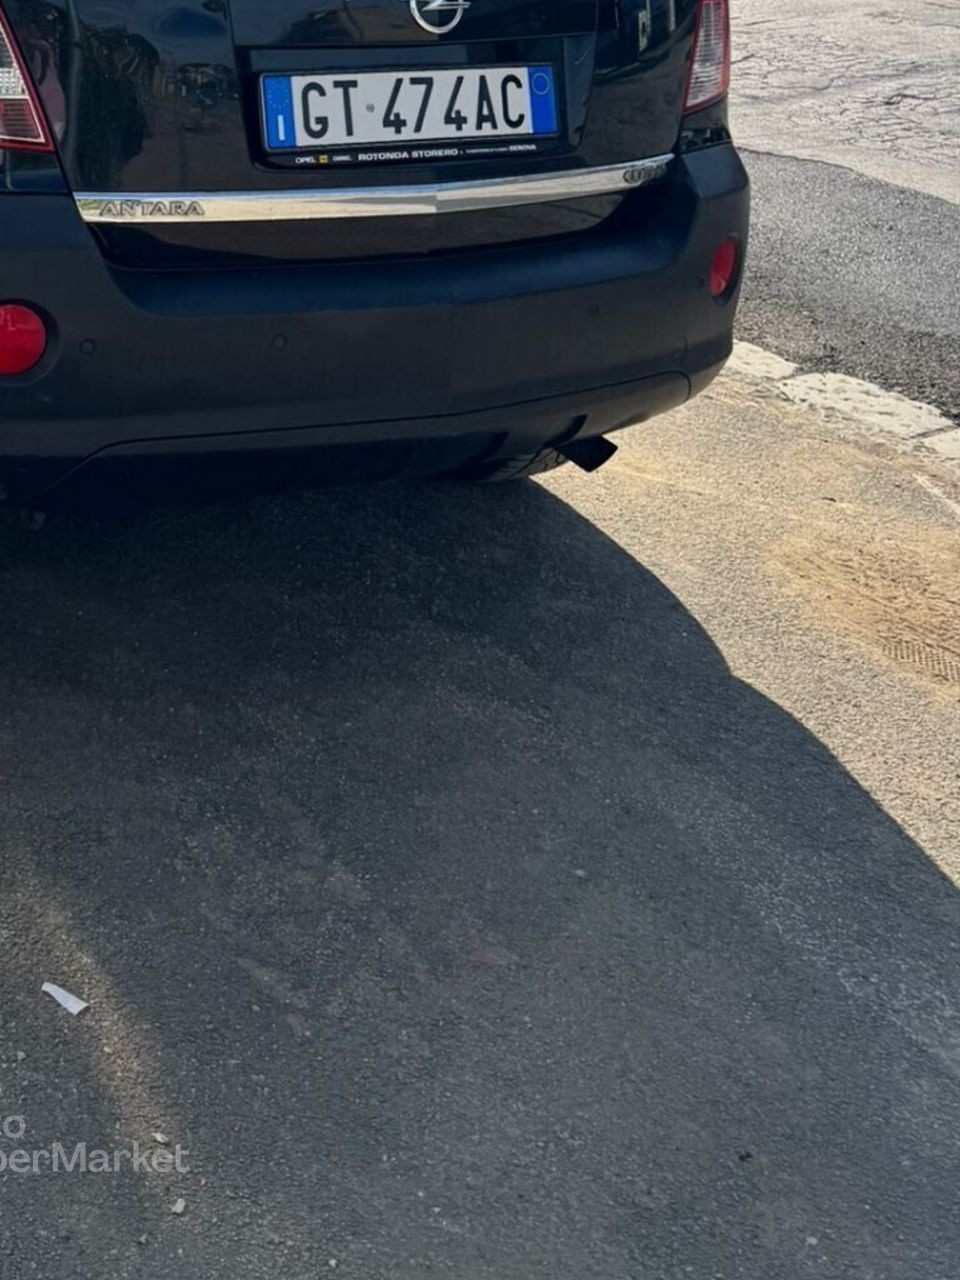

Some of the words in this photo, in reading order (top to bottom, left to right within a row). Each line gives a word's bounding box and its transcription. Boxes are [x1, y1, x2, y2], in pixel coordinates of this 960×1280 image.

[301, 80, 358, 139] GT
[382, 74, 525, 134] 474AC
[358, 150, 409, 161] ROTONDA
[411, 148, 458, 158] STORERO
[99, 200, 205, 216] ANTARA
